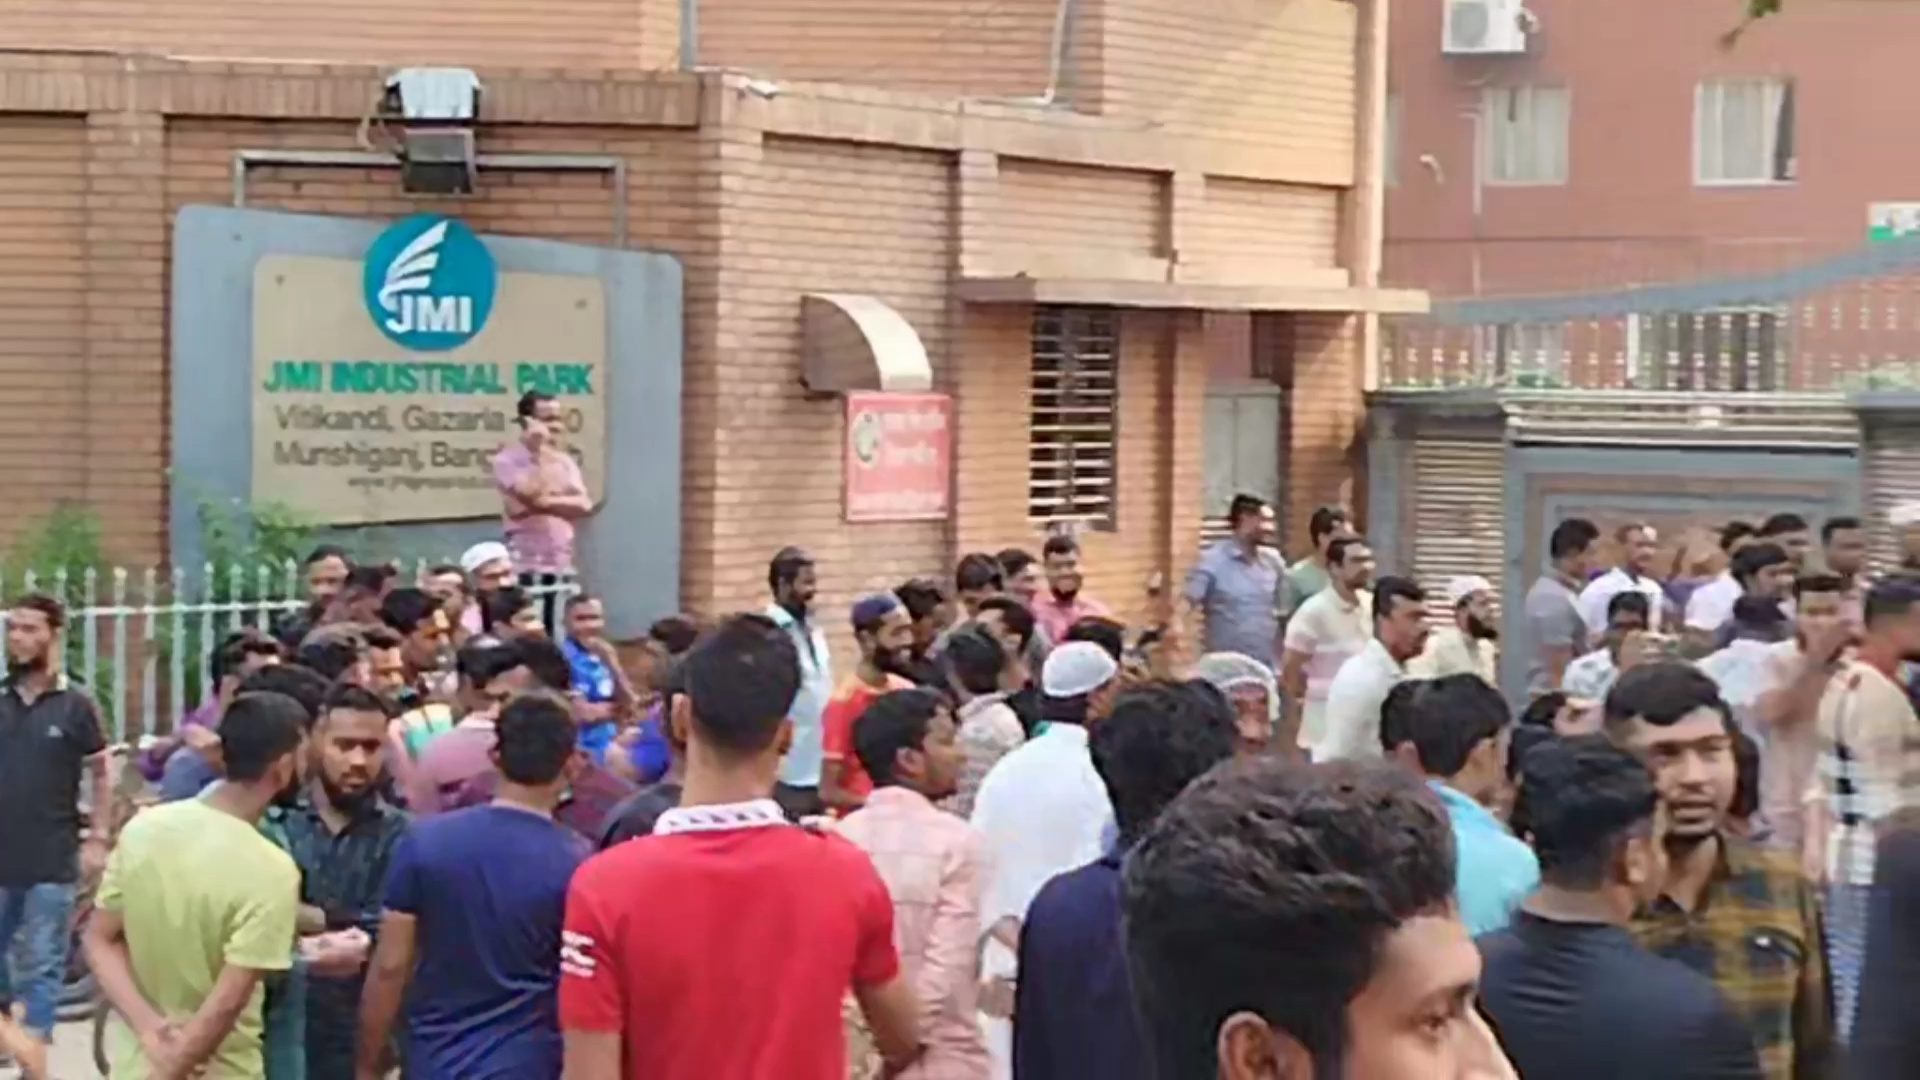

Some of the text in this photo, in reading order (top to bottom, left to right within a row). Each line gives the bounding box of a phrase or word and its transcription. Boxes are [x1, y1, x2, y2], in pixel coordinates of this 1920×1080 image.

[385, 295, 472, 334] JMI
[263, 361, 594, 395] JMI INDUSTRIAL PARK
